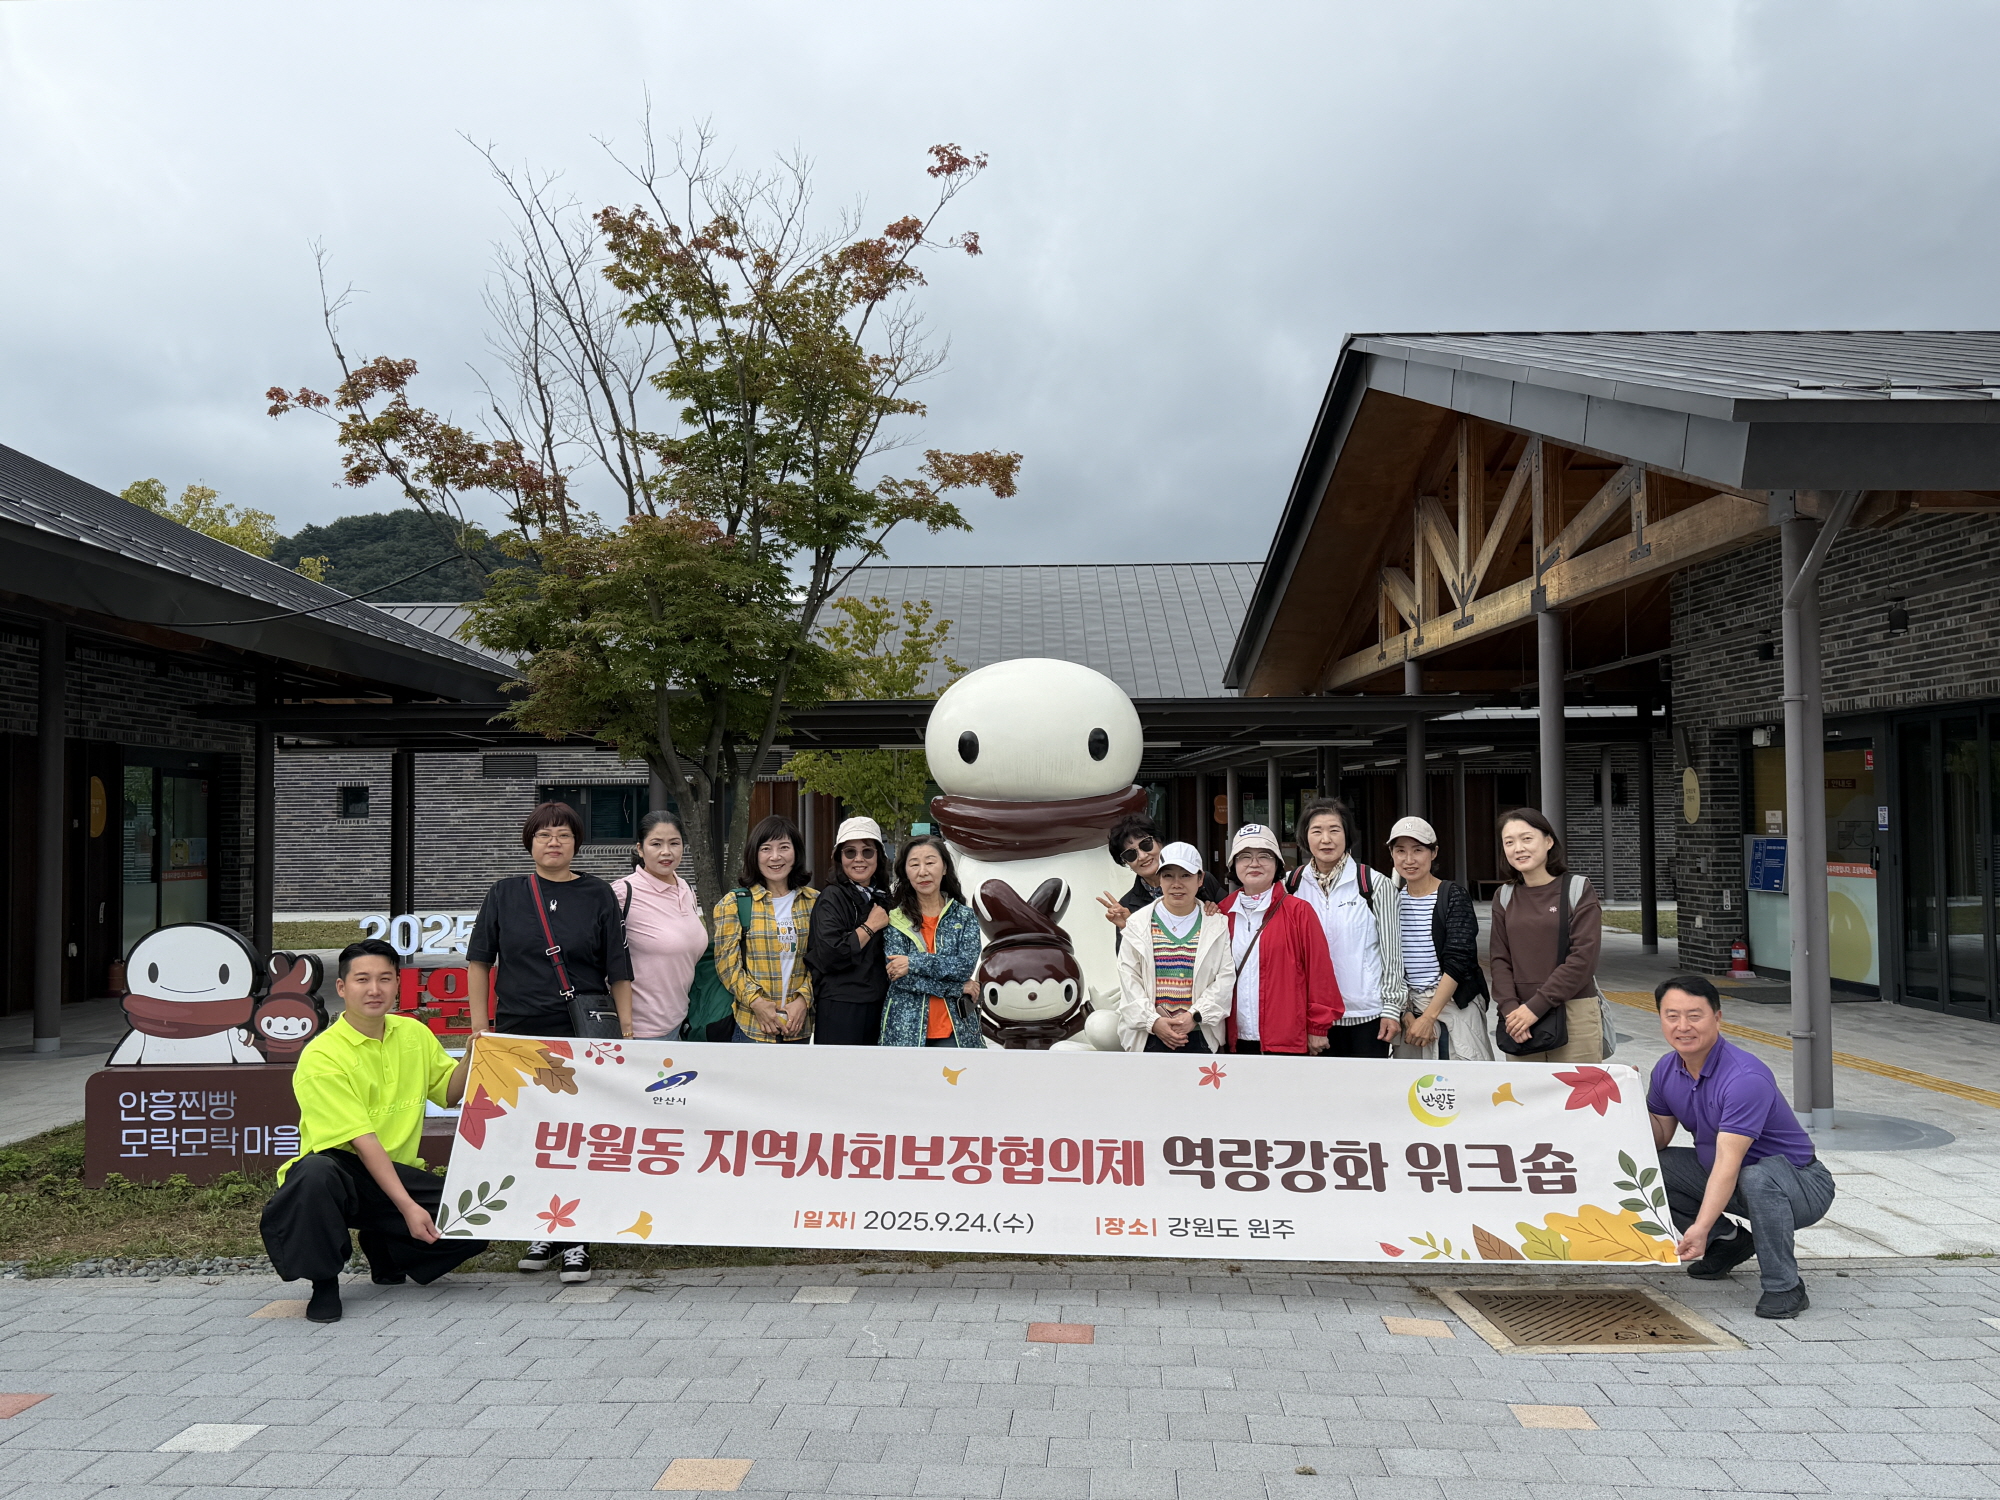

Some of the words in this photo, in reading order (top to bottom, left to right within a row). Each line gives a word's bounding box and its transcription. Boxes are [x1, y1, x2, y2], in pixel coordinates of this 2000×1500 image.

[118, 1090, 238, 1122] 안흥찐빵
[652, 1096, 686, 1106] 안산시
[1421, 1093, 1456, 1111] 반월동
[119, 1127, 240, 1157] 모락모락
[243, 1125, 300, 1156] 마을
[535, 1121, 686, 1176] 반월동
[697, 1129, 1145, 1187] 지역사회보장협의체
[1162, 1135, 1389, 1194] 역량강화
[1404, 1142, 1578, 1195] 워크숍
[863, 1210, 1035, 1235] 2025.9.24.(수)
[1167, 1217, 1240, 1238] 강원도
[1247, 1218, 1296, 1240] 원주
